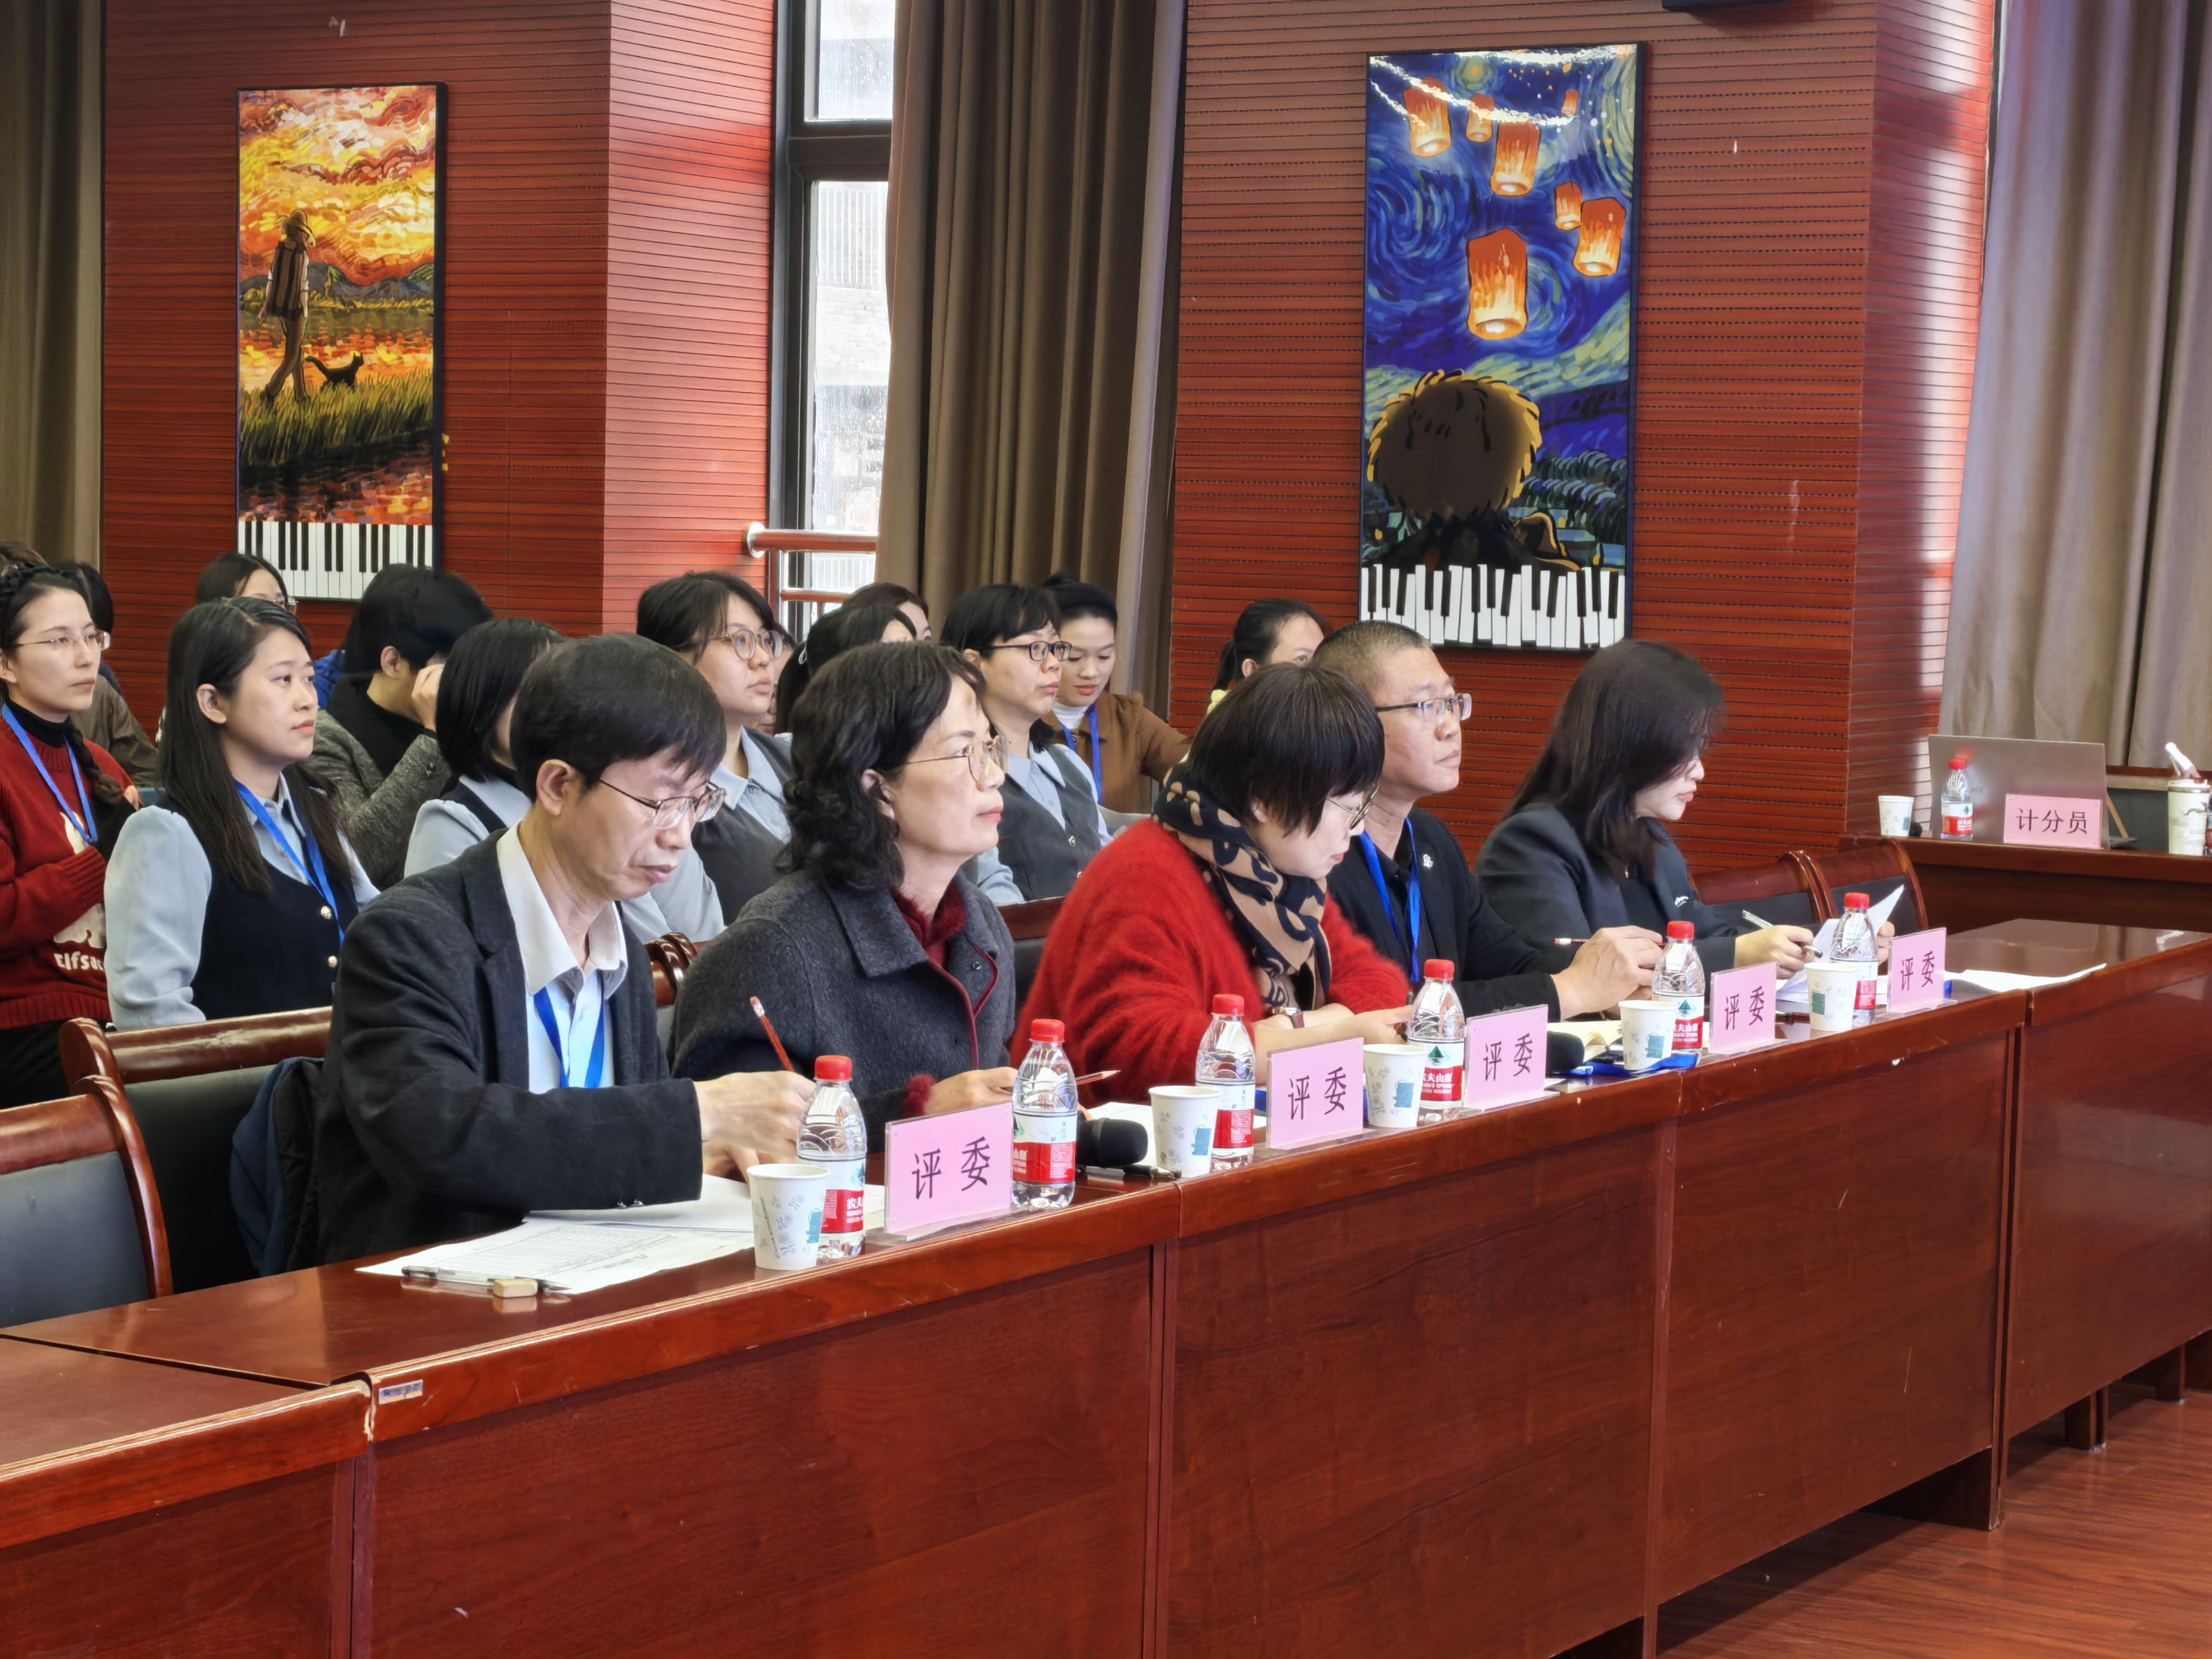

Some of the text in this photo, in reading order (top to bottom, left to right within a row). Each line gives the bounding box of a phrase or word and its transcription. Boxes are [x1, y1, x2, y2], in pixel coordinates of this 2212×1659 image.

[2015, 808, 2087, 834] 计分员
[1900, 950, 1935, 991] 评委
[1724, 986, 1765, 1030] 评委
[1423, 1072, 1453, 1083] 夫山
[1482, 1033, 1533, 1082] 评委
[1287, 1066, 1347, 1121] 评委
[911, 1136, 991, 1201] 评委
